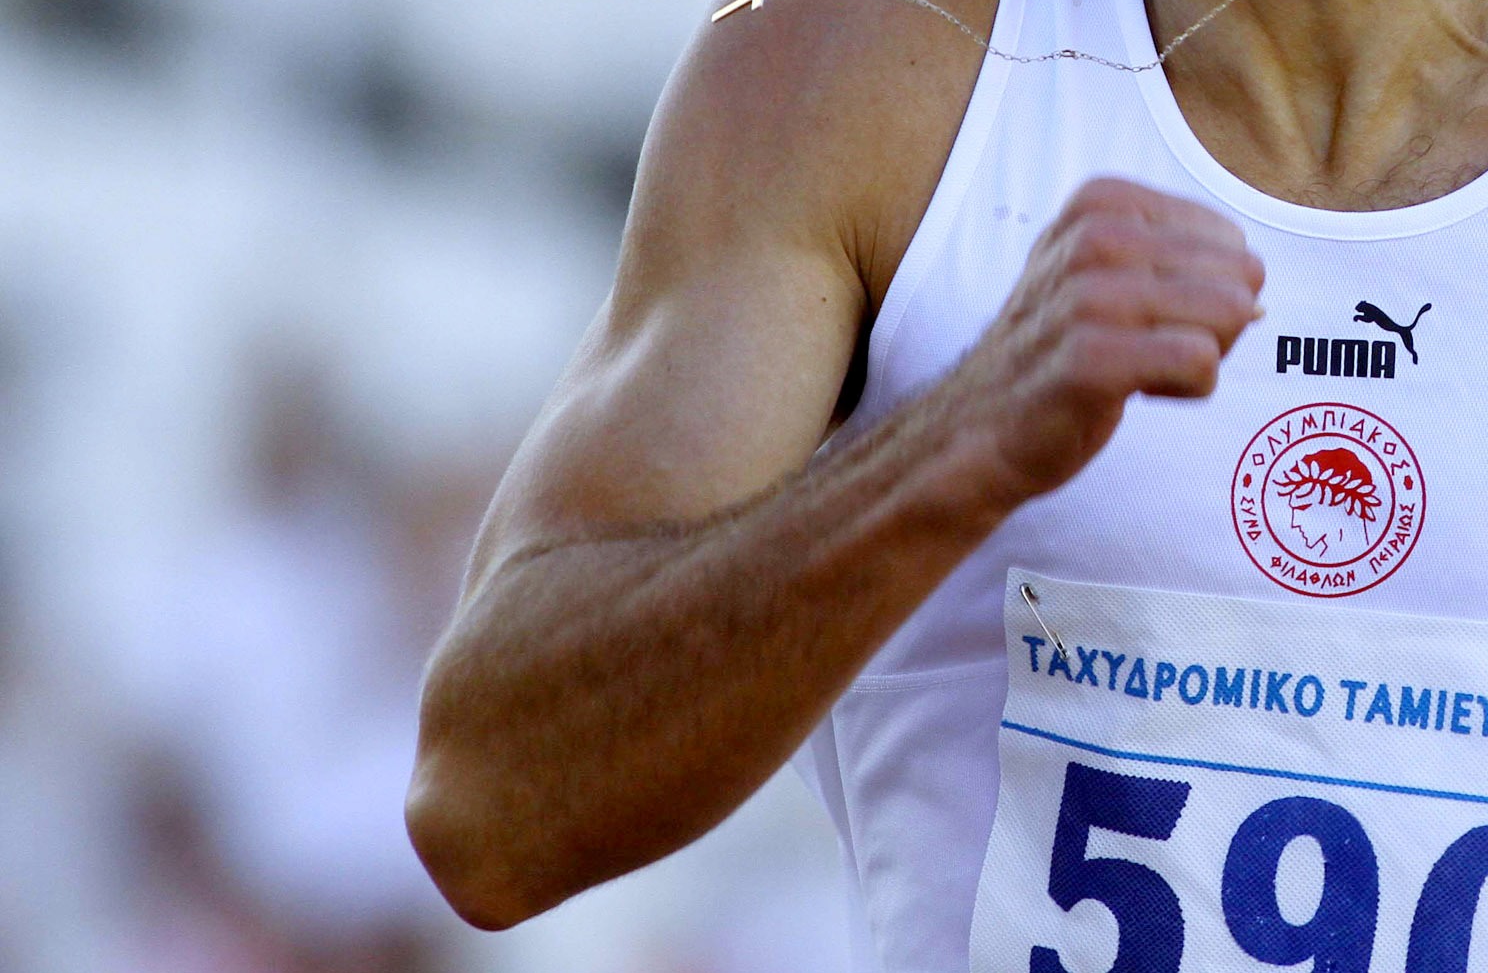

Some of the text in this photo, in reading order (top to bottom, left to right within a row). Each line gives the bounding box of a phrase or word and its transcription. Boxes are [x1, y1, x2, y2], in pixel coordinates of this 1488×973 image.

[1276, 335, 1396, 379] PUMA
[1252, 410, 1411, 476] ΟΛΥΜΠΙΑΚΟΣ
[1270, 556, 1356, 589] ΦΙΛΑΘΛΩΝ
[1369, 503, 1416, 575] ΠΕΙΡΑΙΩΣ
[1022, 635, 1326, 717] ΤΑΧΥΔΡΟΜΙΚΟ
